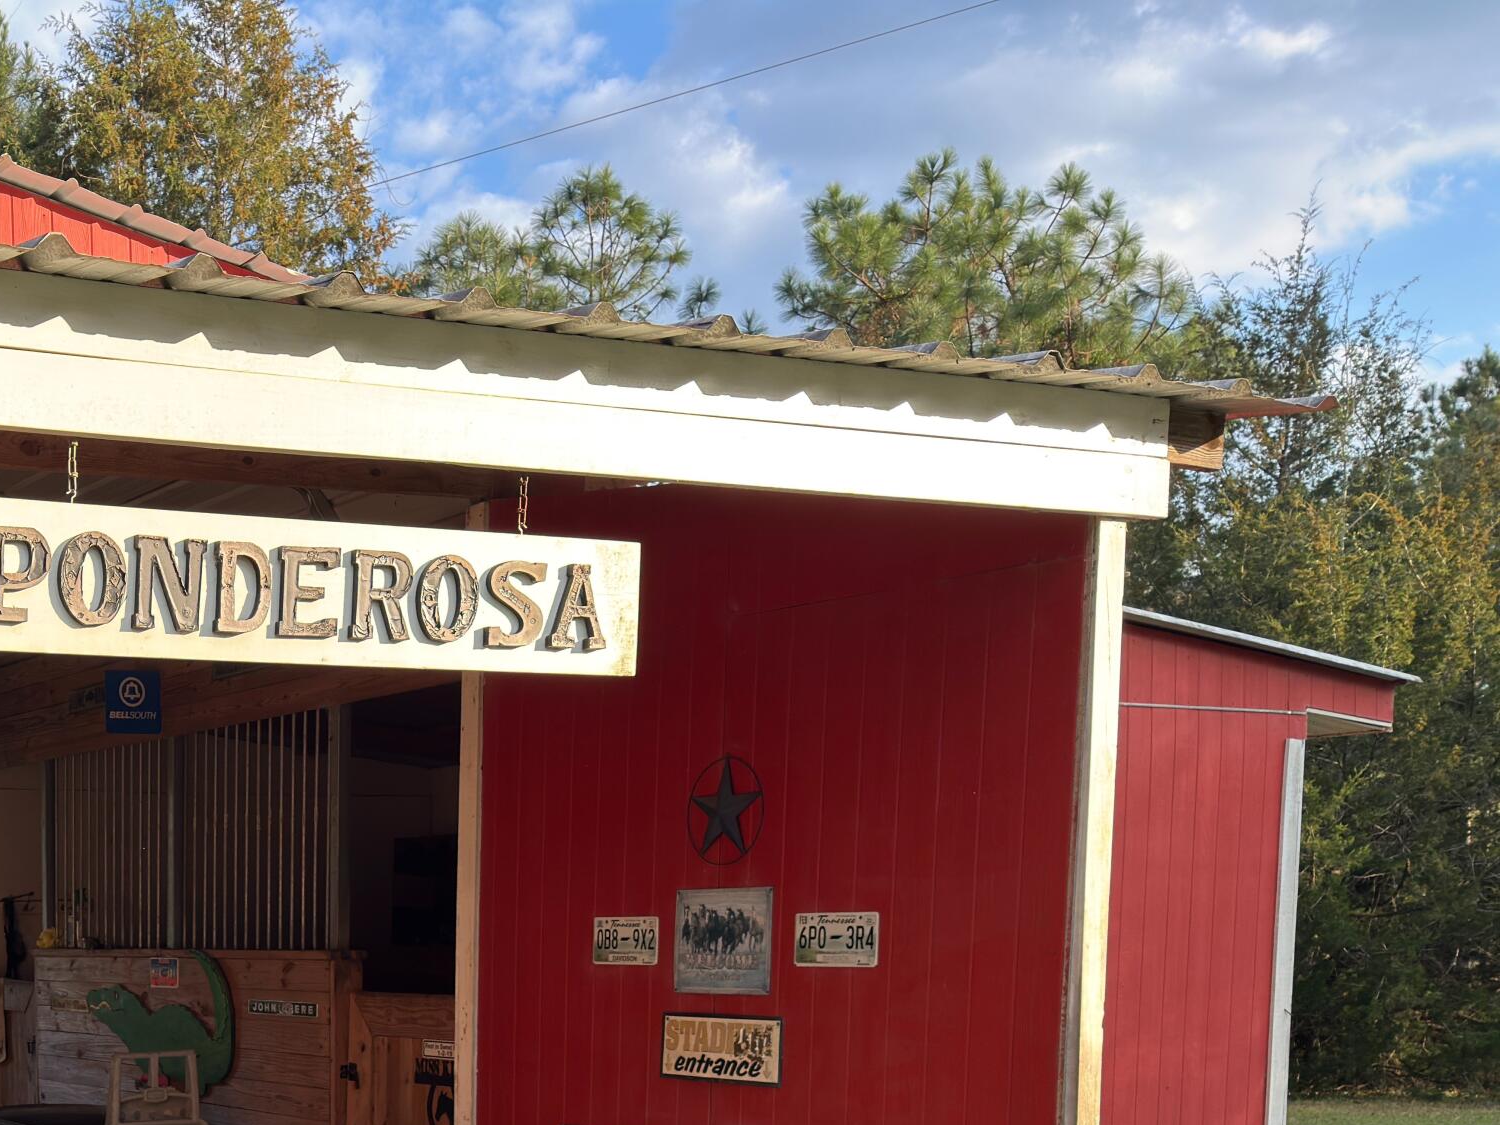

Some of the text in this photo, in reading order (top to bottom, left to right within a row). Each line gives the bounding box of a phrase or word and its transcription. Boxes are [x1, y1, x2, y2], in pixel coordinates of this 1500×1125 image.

[108, 710, 157, 720] BELLSOUTH
[817, 915, 856, 926] Tennessee
[252, 1002, 314, 1016] JOHN ERE
[674, 1054, 762, 1077] entrance
